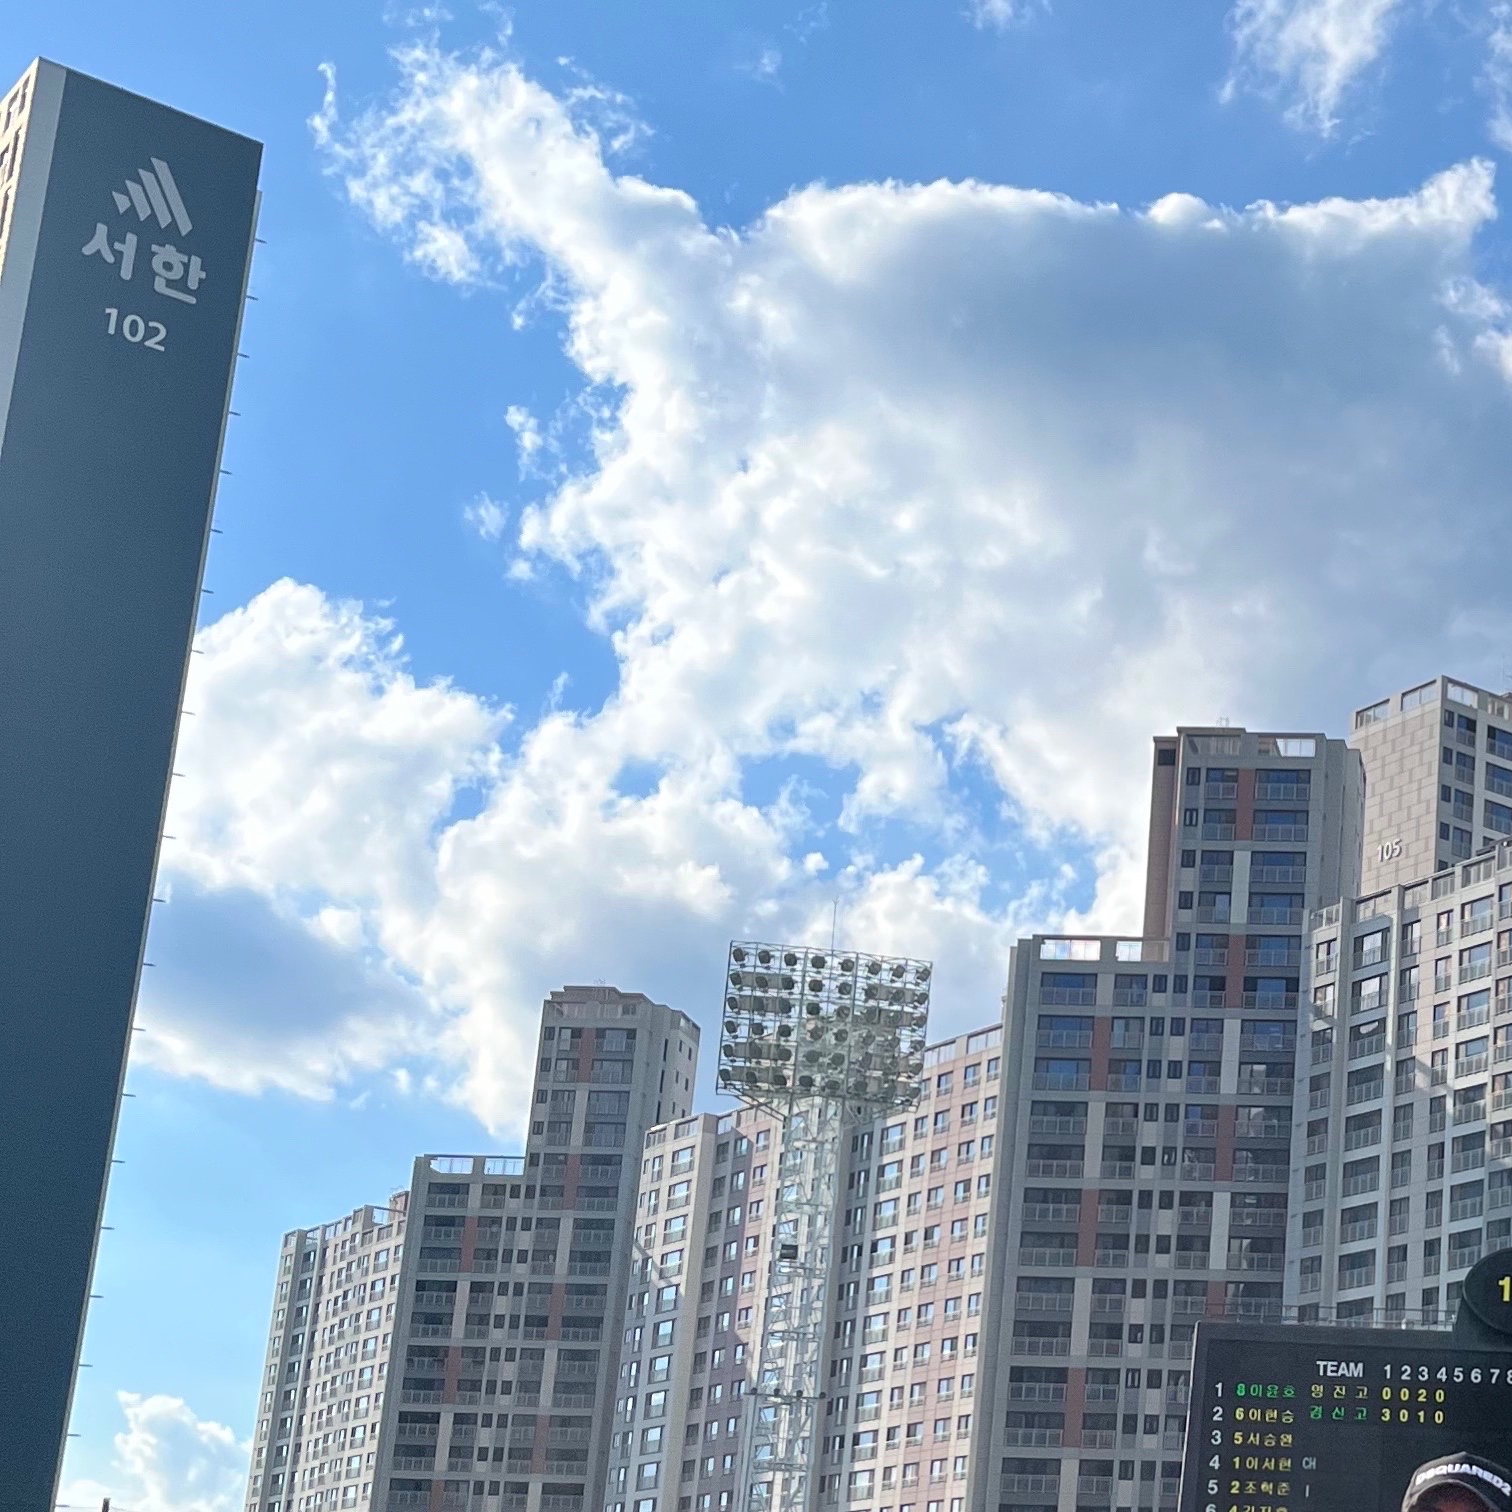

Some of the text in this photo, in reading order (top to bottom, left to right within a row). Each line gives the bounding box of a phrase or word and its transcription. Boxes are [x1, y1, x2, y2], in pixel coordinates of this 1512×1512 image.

[81, 222, 207, 305] 서한
[105, 307, 167, 351] 102
[1376, 838, 1402, 862] 105
[1317, 1361, 1363, 1377] TEAM
[1384, 1365, 1390, 1378] 1
[1401, 1365, 1411, 1380] 2
[1418, 1367, 1428, 1381] 3
[1437, 1367, 1447, 1382] 4
[1454, 1368, 1463, 1382] 5
[1471, 1369, 1481, 1383] 6
[1490, 1369, 1500, 1383] 7
[1216, 1383, 1222, 1397] 1
[1383, 1387, 1391, 1399] 0
[1401, 1388, 1409, 1400] 0
[1418, 1389, 1426, 1401] 2
[1436, 1390, 1444, 1402] 0
[1213, 1407, 1222, 1420] 2
[1382, 1409, 1390, 1421] 3
[1400, 1410, 1408, 1422] 0
[1418, 1411, 1424, 1422] 1
[1435, 1411, 1443, 1423] 0
[1211, 1430, 1221, 1444] 3
[1209, 1455, 1220, 1469] 4
[1208, 1480, 1218, 1494] 5
[1415, 1463, 1512, 1497] DSQUARED2
